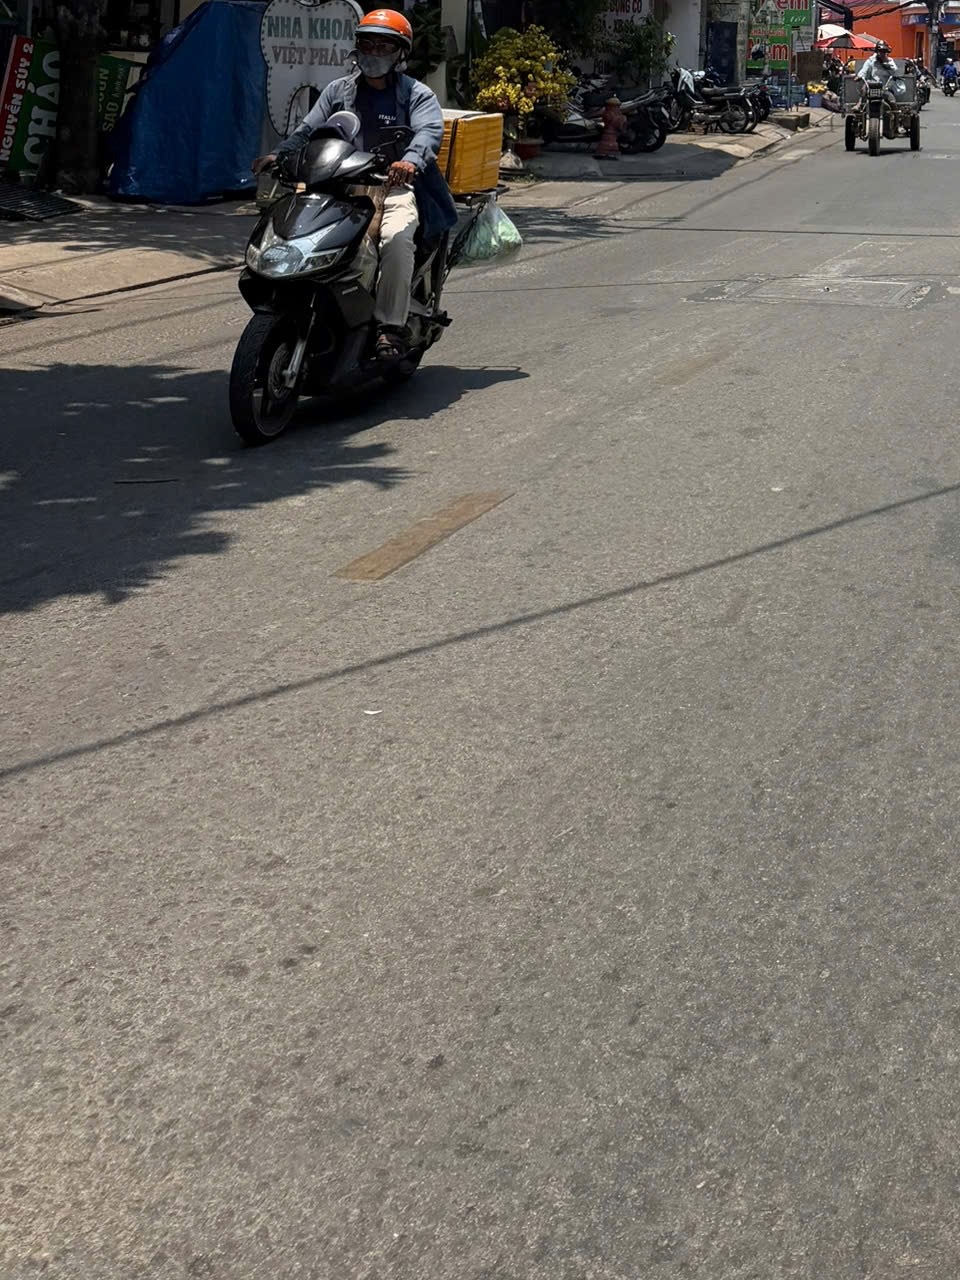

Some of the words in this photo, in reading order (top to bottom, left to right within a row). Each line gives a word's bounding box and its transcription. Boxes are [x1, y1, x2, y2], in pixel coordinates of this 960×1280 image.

[267, 16, 301, 39] NHA
[308, 17, 353, 40] KHOA
[272, 42, 306, 70] VIỆT
[309, 43, 349, 67] PHÁP
[0, 93, 24, 161] NGUYỄN
[14, 57, 31, 90] SÚY
[23, 43, 34, 54] 2
